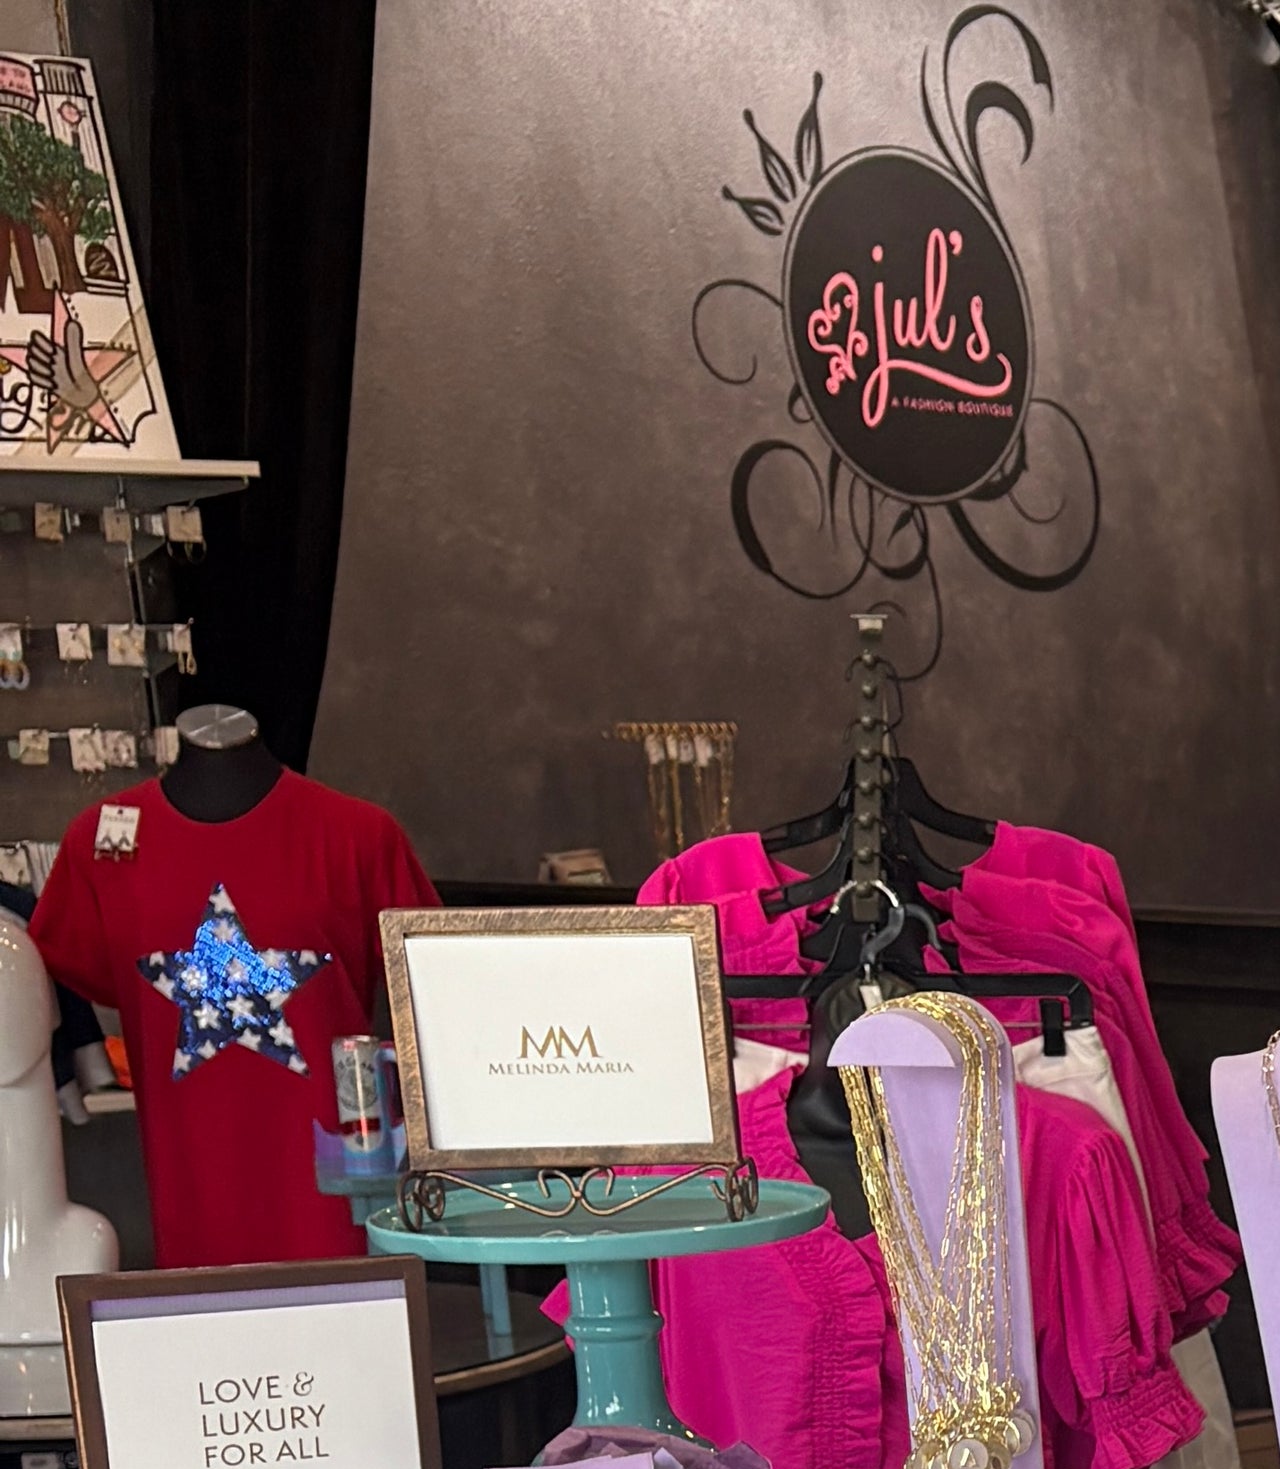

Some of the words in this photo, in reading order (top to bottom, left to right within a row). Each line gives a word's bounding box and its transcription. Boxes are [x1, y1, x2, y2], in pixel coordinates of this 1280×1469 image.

[862, 228, 1013, 428] jul's
[903, 396, 955, 413] FASHION
[957, 400, 1014, 418] BOUTIQUE
[517, 1024, 604, 1060] MM
[488, 1060, 571, 1076] MELINDA
[576, 1060, 635, 1075] MARIA
[199, 1375, 283, 1406] LOVE
[292, 1371, 316, 1397] &
[202, 1403, 326, 1438] LUXURY
[204, 1442, 267, 1469] FOR
[275, 1436, 330, 1463] ALL
